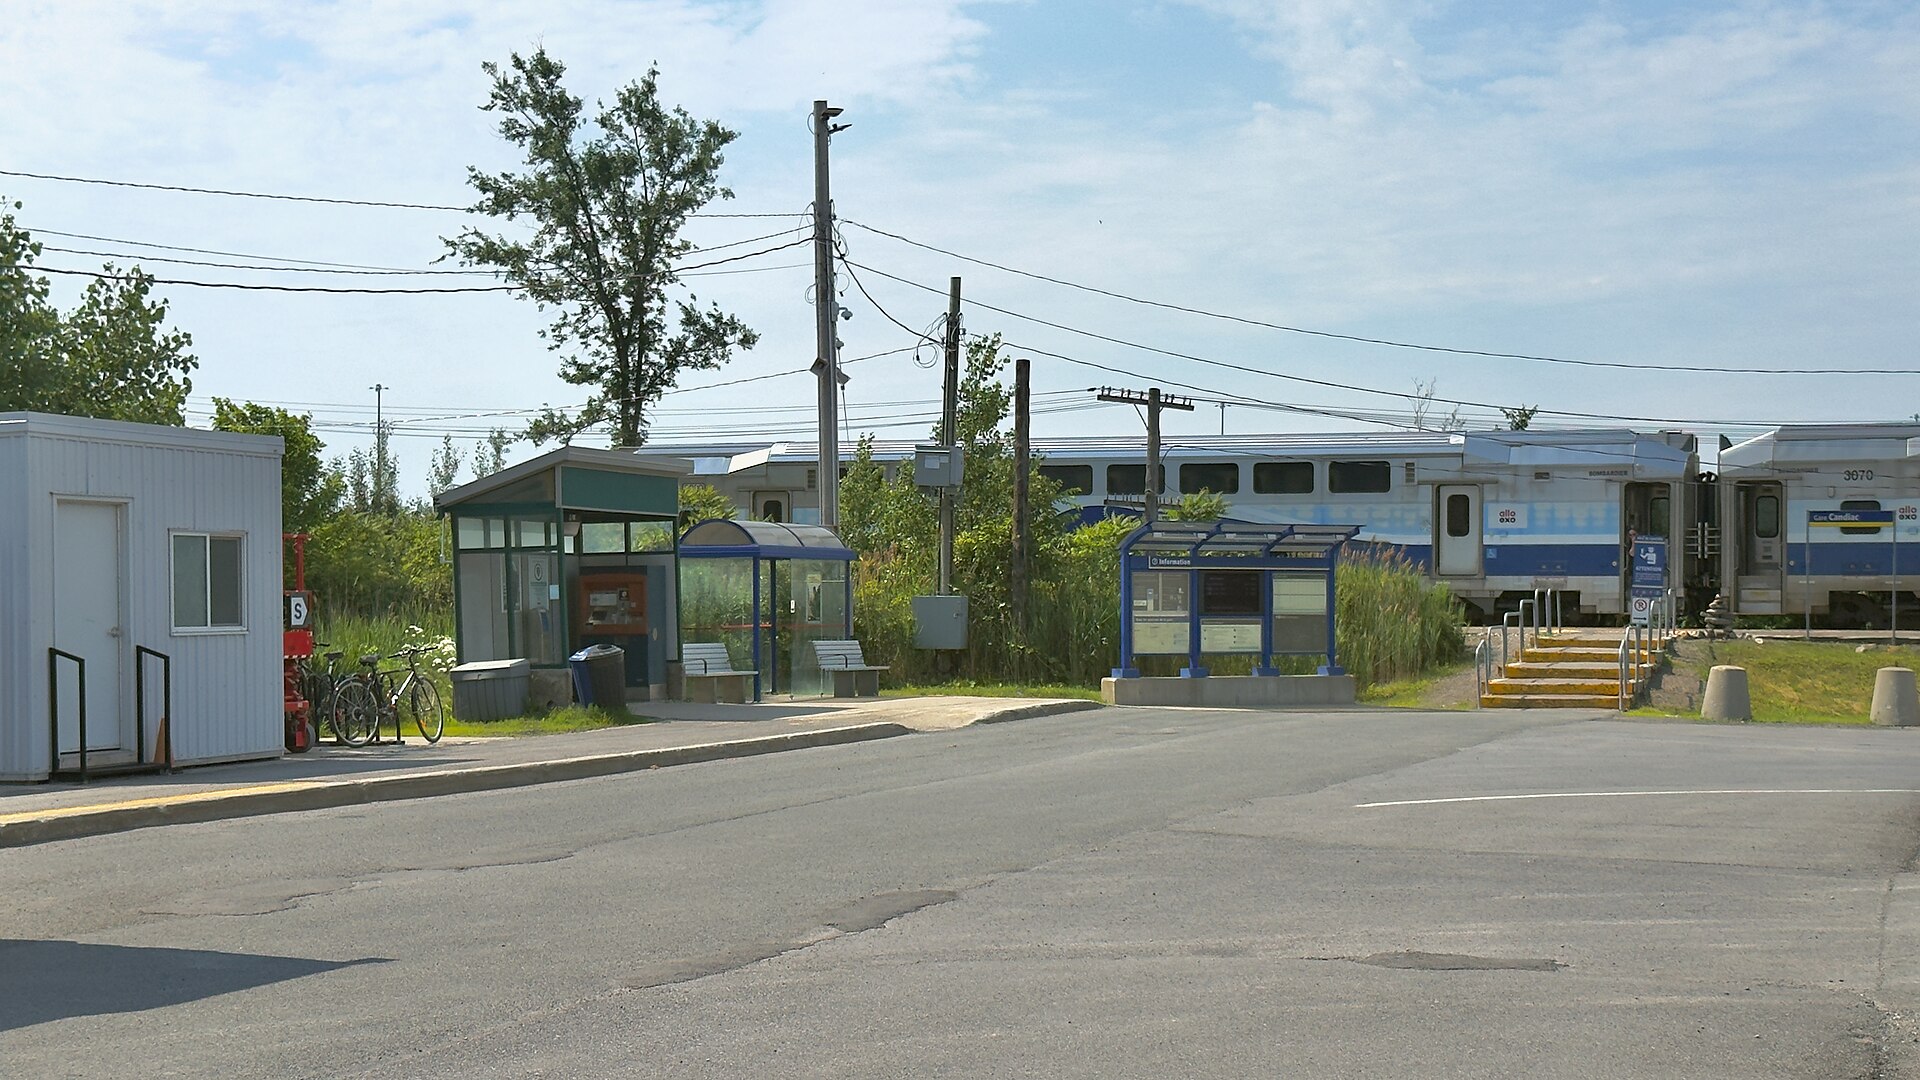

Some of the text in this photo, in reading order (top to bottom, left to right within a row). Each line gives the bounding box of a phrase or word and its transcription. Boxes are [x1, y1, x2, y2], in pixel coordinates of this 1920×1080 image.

[1843, 470, 1873, 481] 3070
[1499, 509, 1516, 517] allo
[1898, 505, 1917, 513] allo
[1828, 512, 1860, 521] Candiac
[294, 603, 302, 619] S
